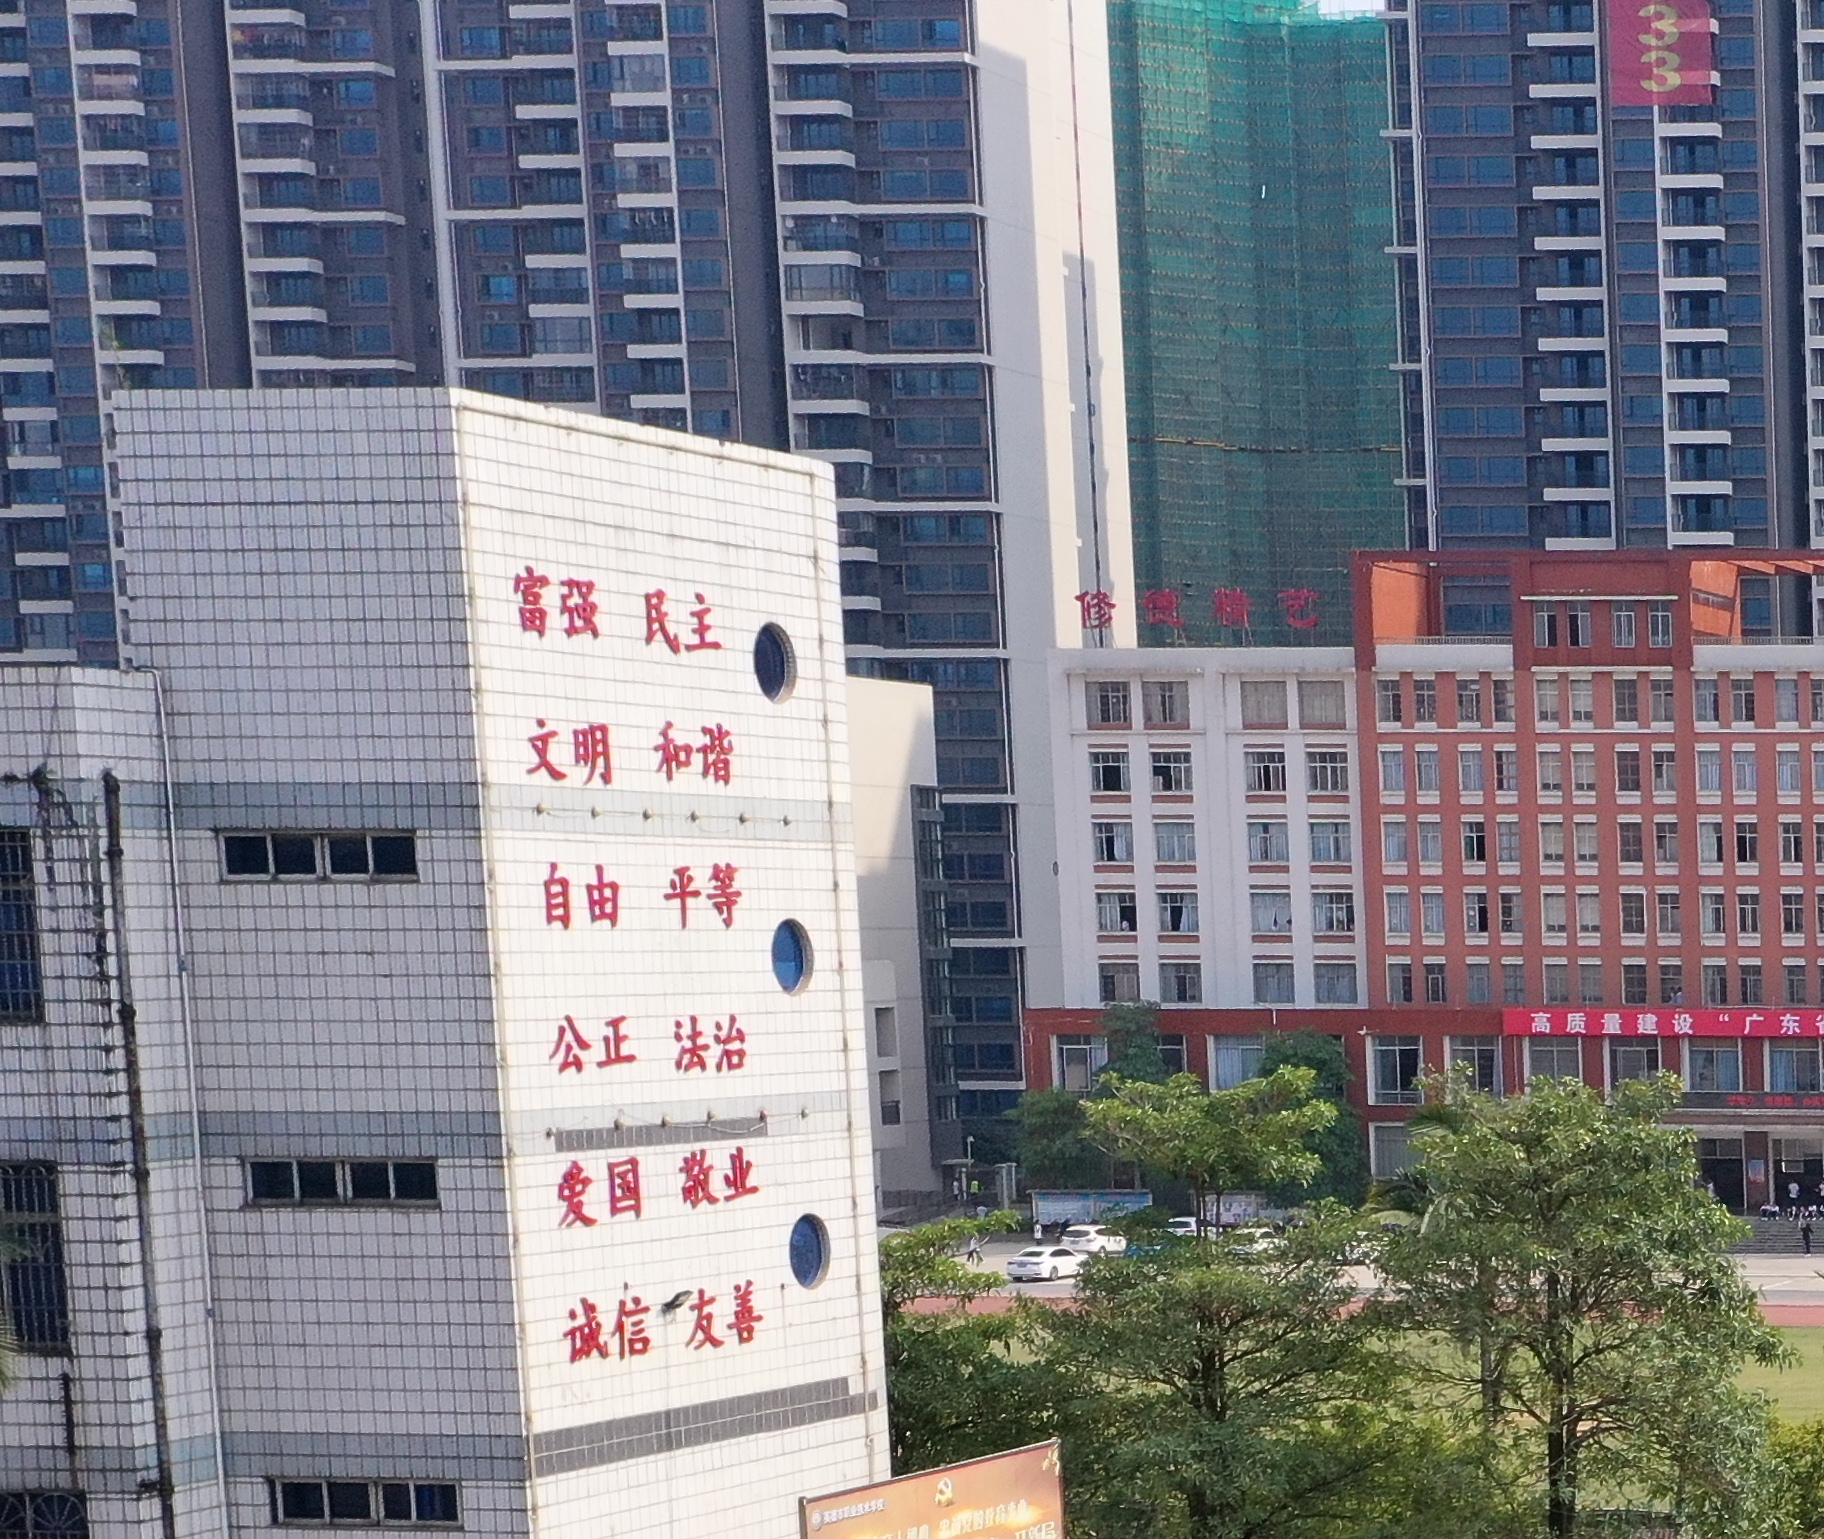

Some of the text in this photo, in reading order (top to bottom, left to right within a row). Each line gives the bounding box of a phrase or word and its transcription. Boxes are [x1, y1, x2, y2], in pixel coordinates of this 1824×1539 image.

[514, 565, 723, 654] 富强 民主
[526, 718, 734, 786] 文明 和谐
[543, 861, 743, 930] 自由 平等
[550, 1013, 747, 1074] 公正 法治
[557, 1145, 760, 1228] 爱国 敬业
[562, 1279, 764, 1363] 诚信 友善
